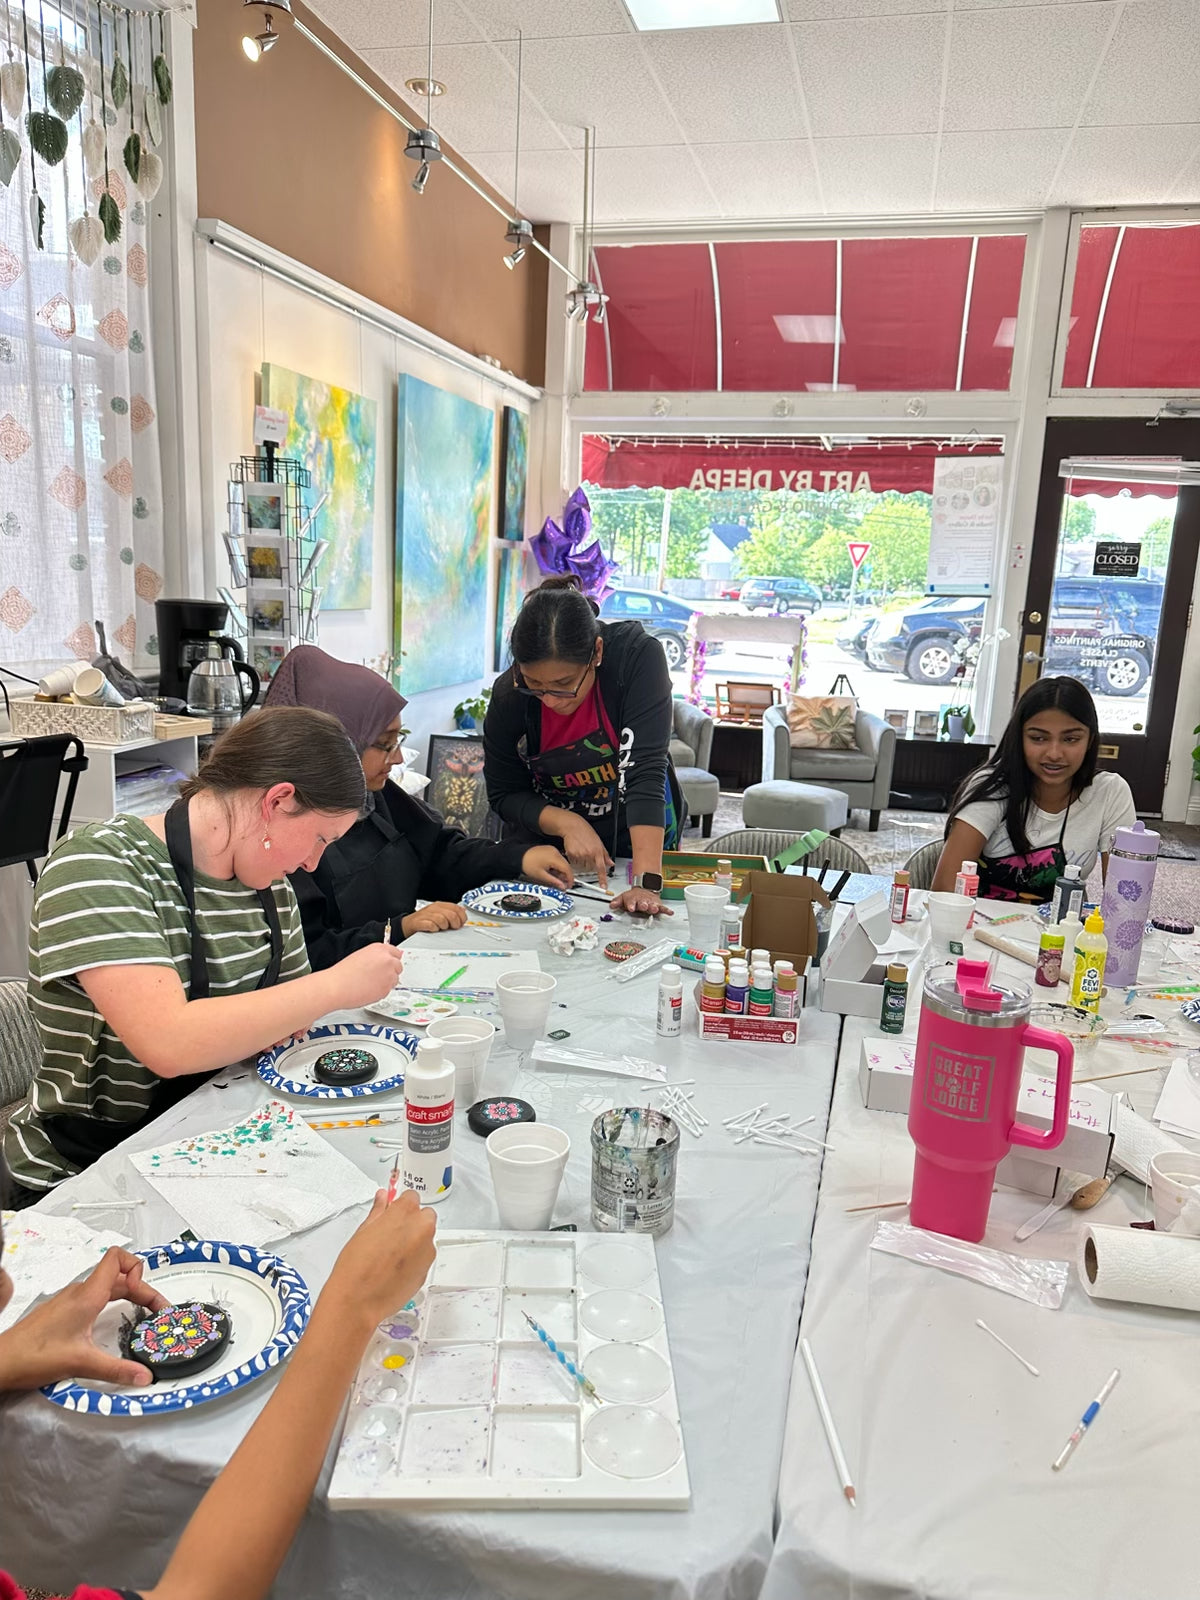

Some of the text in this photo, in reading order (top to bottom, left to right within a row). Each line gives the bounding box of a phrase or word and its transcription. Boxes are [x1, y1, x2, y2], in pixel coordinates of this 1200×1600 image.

[1096, 554, 1139, 565] CLOSED
[551, 762, 617, 789] EARTH
[1082, 978, 1099, 987] FEVI
[1081, 985, 1099, 993] GUM
[935, 1055, 983, 1080] GREAT
[934, 1071, 981, 1096] WOLF
[931, 1086, 979, 1112] LODGE
[407, 1109, 427, 1120] craft
[416, 1183, 426, 1191] ml
